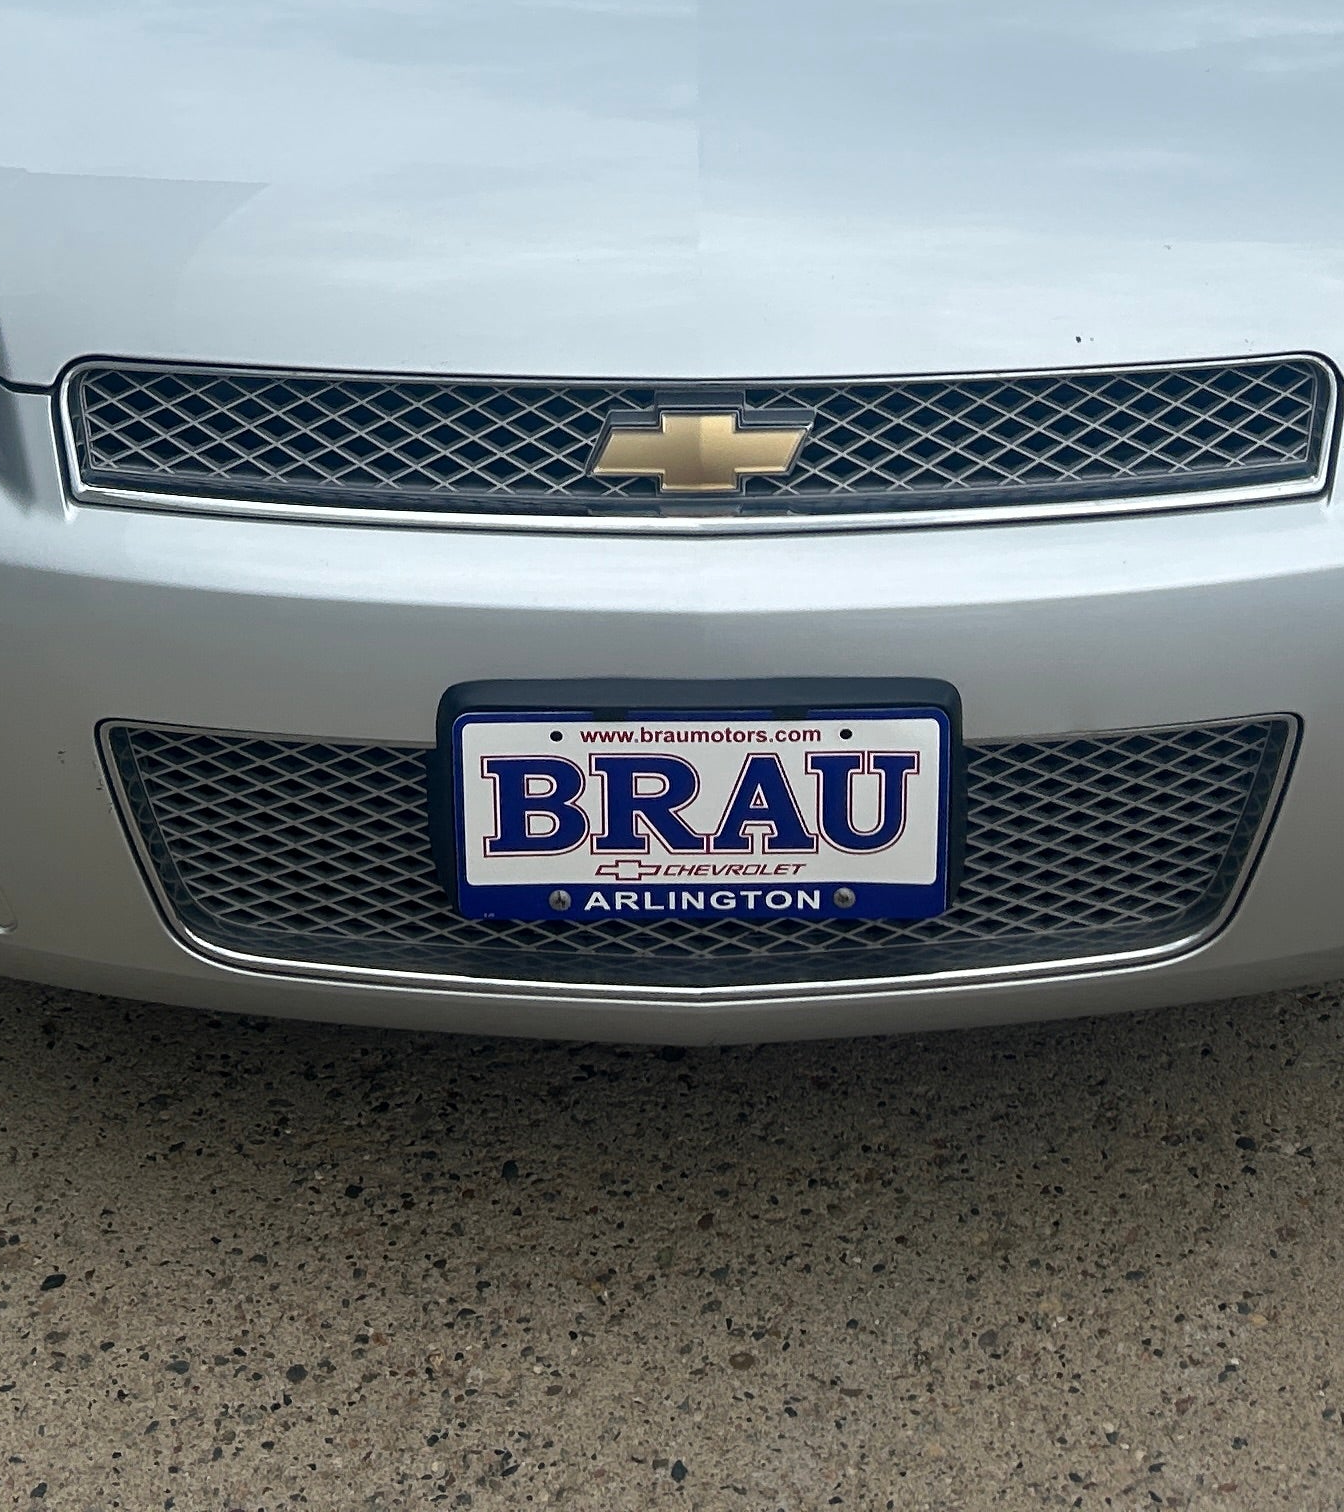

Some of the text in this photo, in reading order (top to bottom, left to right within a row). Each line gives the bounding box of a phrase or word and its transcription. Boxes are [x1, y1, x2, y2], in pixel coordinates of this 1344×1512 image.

[580, 726, 822, 745] www.braumotors.com
[480, 750, 921, 858] BRAU
[662, 862, 807, 877] CHEVROLET
[583, 889, 822, 911] ARLINGTON
